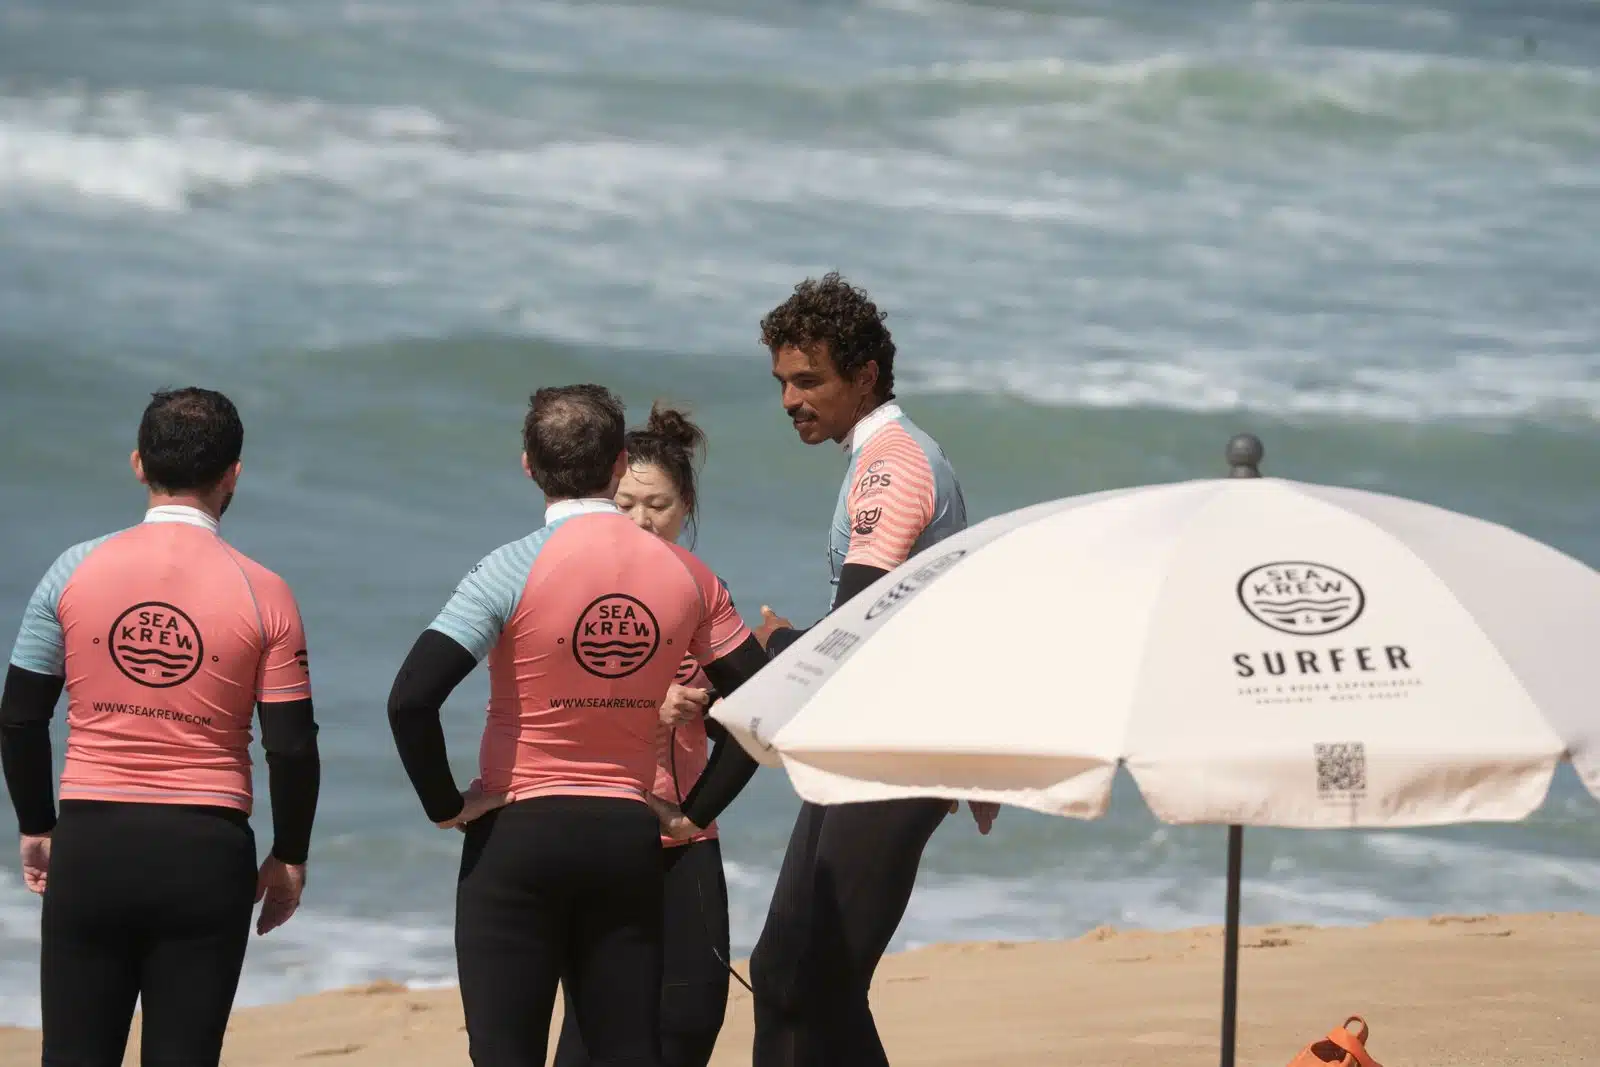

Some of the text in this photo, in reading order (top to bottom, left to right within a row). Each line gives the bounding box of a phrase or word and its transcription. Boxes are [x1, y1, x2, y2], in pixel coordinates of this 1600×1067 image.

[861, 474, 891, 492] FPS
[1267, 569, 1321, 581] SEA
[1253, 580, 1342, 596] KREW
[599, 605, 636, 619] SEA
[139, 612, 178, 631] SEA
[584, 621, 650, 637] KREW
[122, 626, 192, 650] KREW
[1233, 646, 1411, 677] SURFER
[92, 702, 211, 725] WWW.SEAKREW.COM
